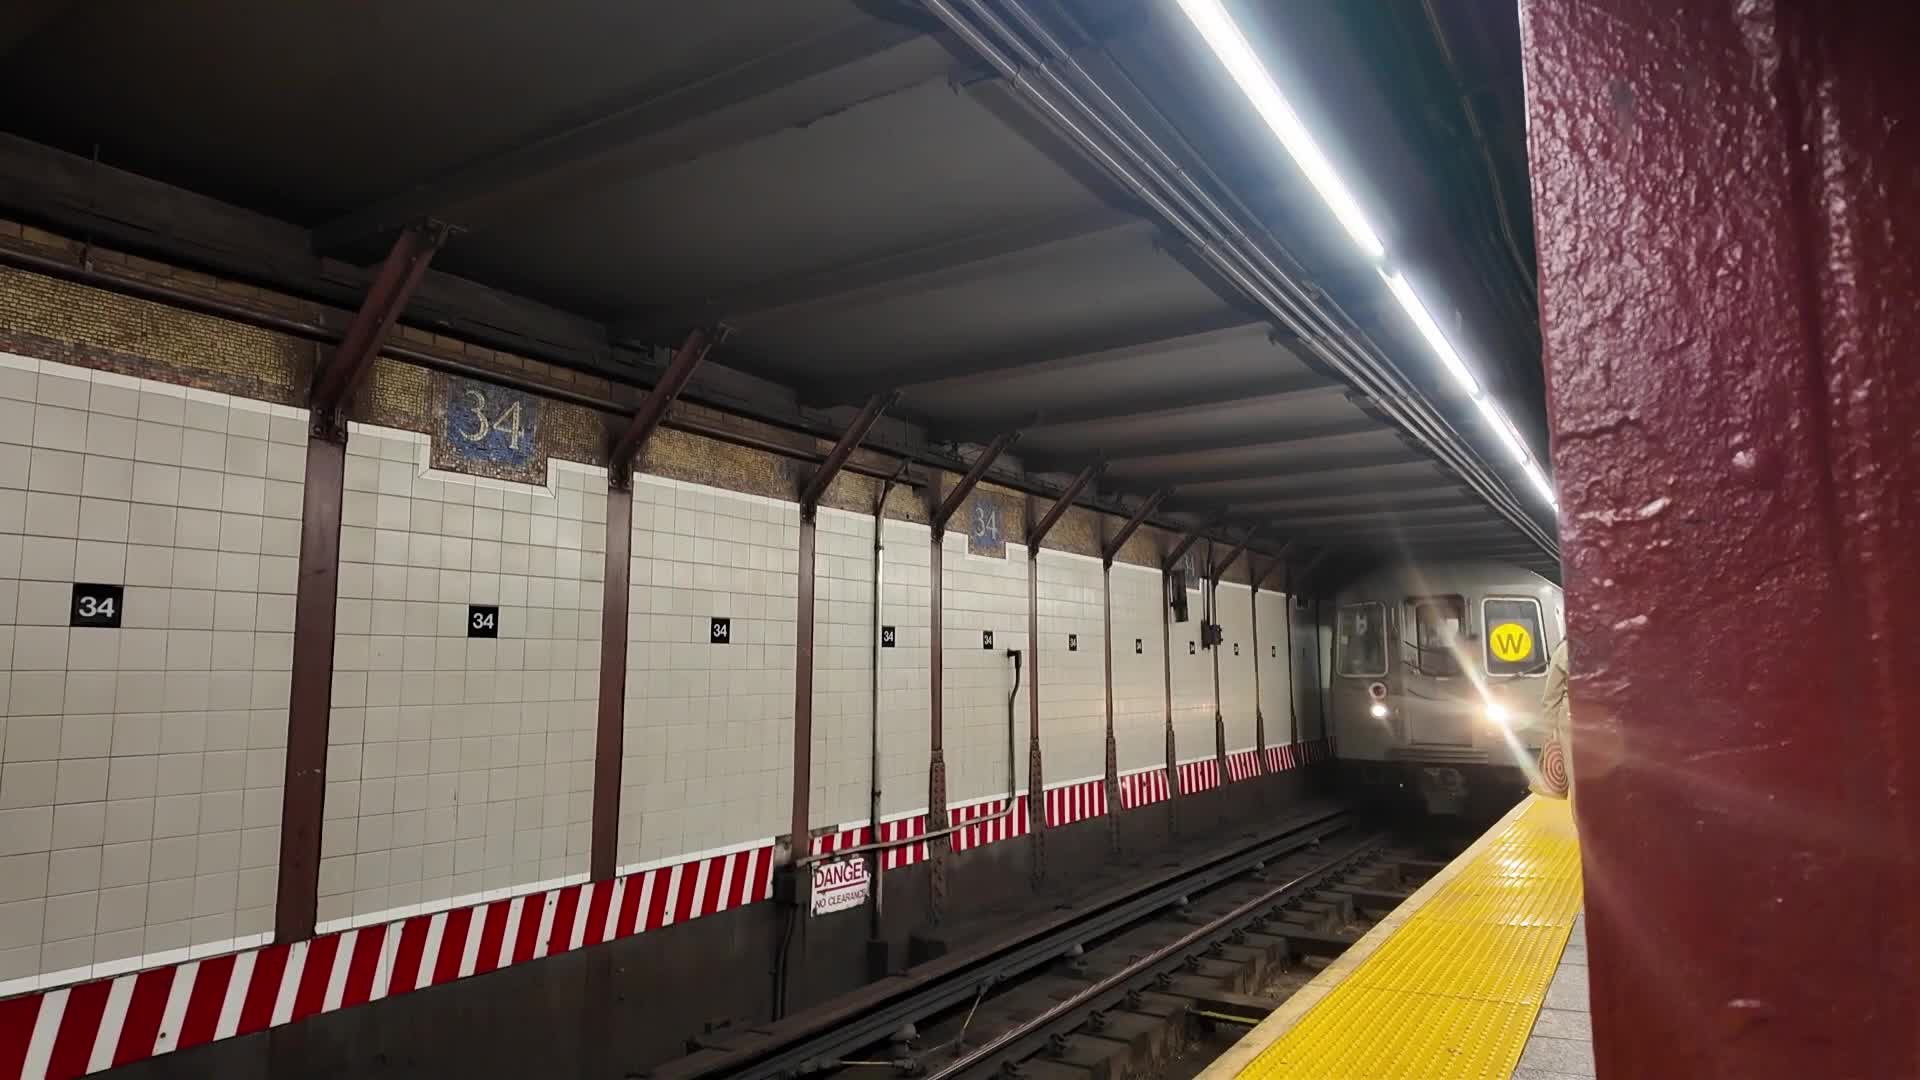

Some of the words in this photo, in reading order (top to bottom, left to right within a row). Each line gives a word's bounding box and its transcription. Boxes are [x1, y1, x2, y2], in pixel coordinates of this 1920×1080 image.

[457, 389, 525, 450] 34
[975, 507, 999, 540] 34
[78, 596, 115, 618] 34
[472, 612, 494, 629] 34
[713, 623, 727, 638] 34
[883, 630, 894, 642] 34
[984, 634, 993, 645] 34
[1496, 633, 1524, 655] W
[815, 898, 826, 909] NO
